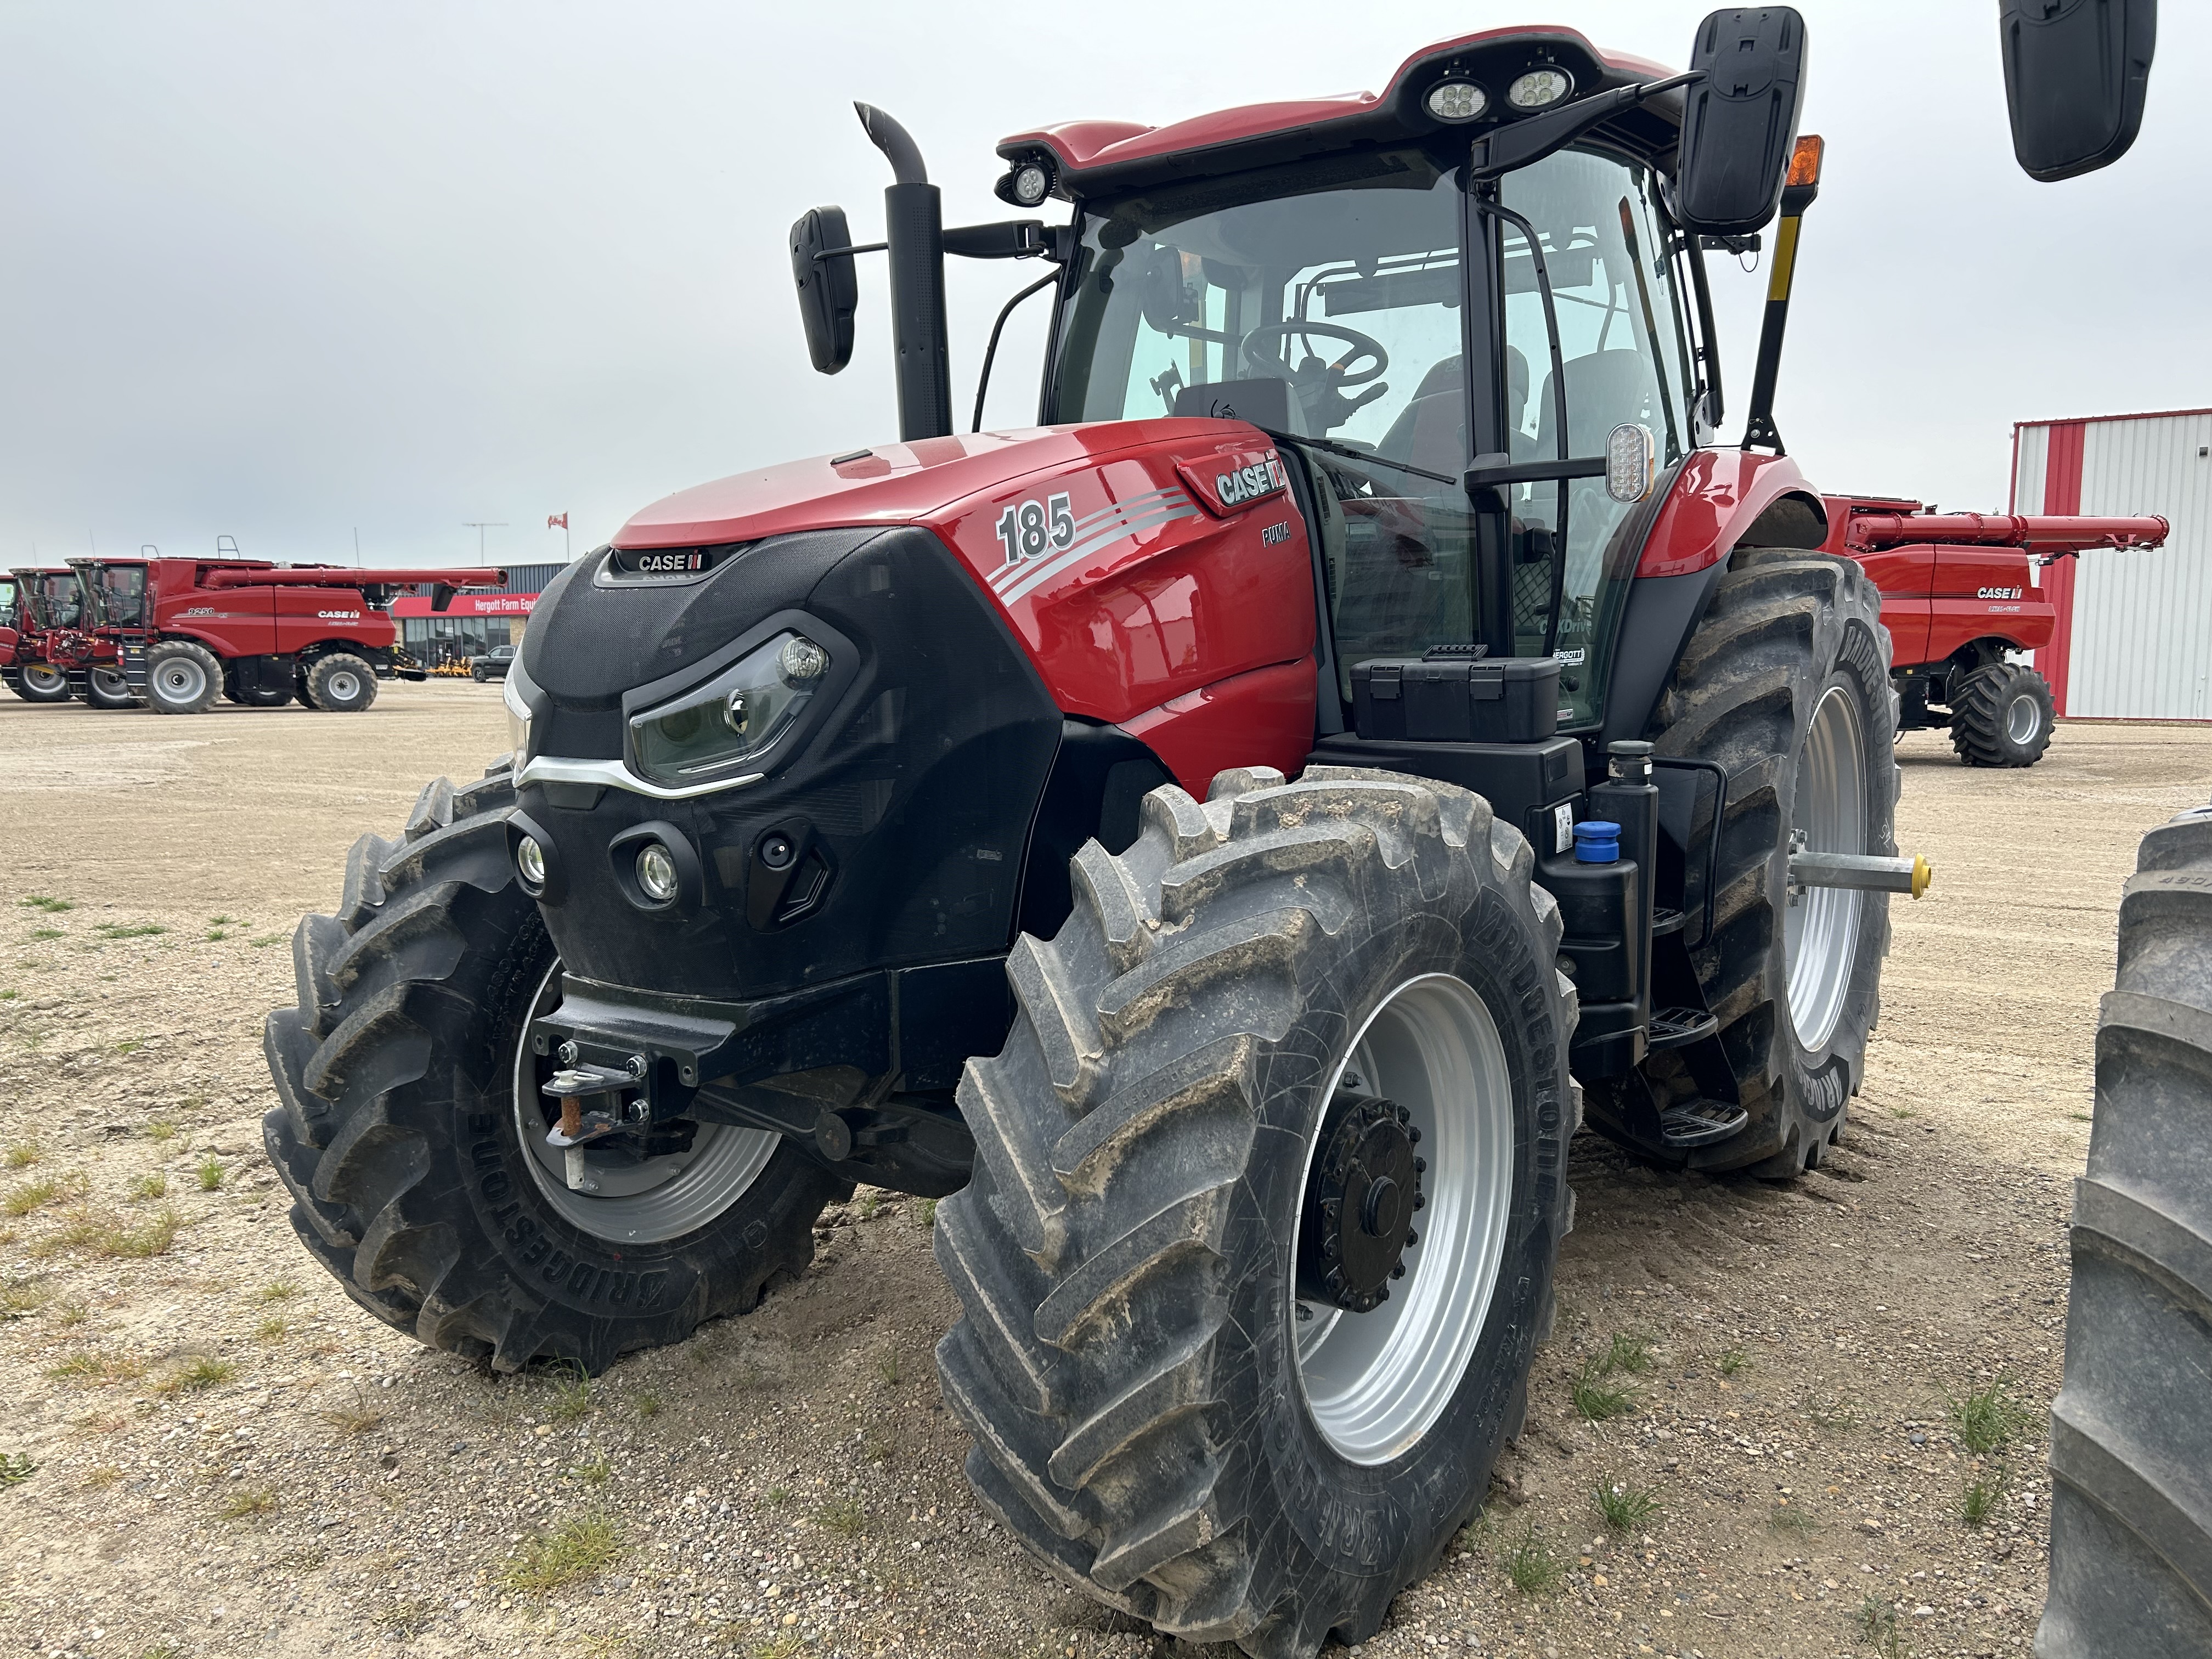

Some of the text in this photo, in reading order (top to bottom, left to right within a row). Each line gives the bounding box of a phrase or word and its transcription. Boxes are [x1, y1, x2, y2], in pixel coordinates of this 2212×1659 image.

[1217, 464, 1269, 504] CASE
[996, 491, 1076, 567] 185
[1262, 521, 1290, 548] PUMA
[639, 555, 685, 571] CASE
[475, 597, 537, 613] Hergott Farm Equi
[1977, 587, 2011, 599] CASE
[1539, 618, 1592, 635] CXDrive
[1471, 901, 1560, 1203] BRIDGESTONE
[467, 1113, 669, 1309] BRIDGESTONE
